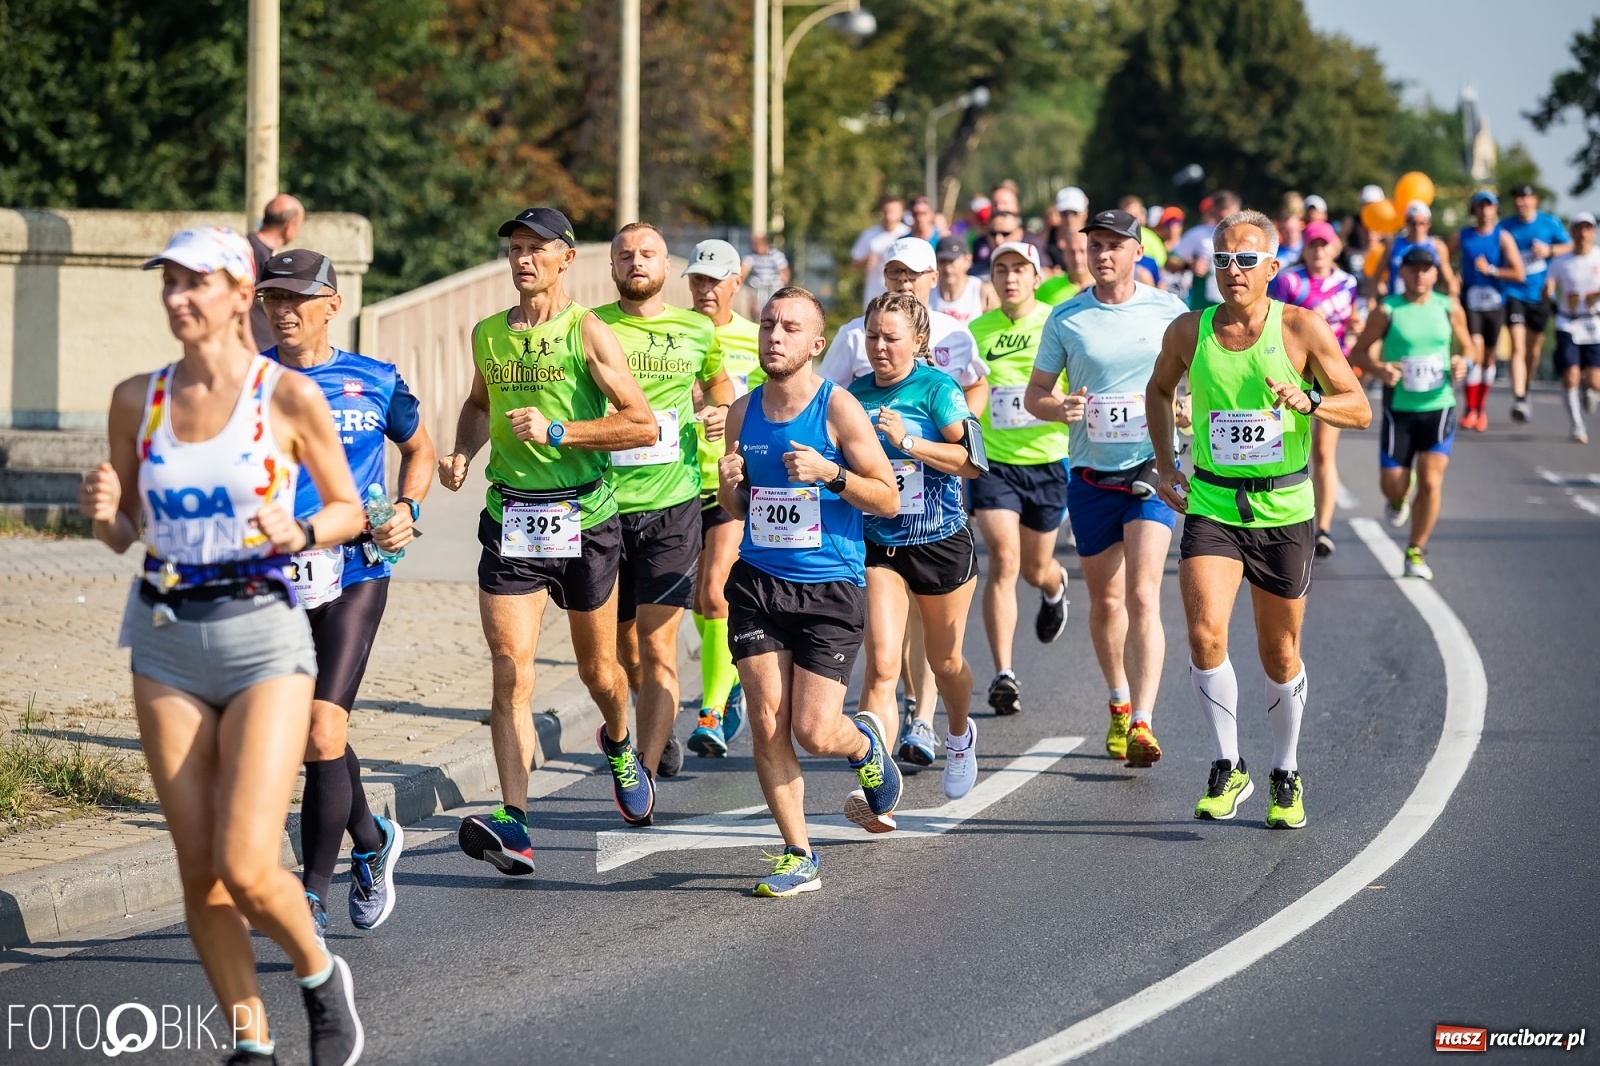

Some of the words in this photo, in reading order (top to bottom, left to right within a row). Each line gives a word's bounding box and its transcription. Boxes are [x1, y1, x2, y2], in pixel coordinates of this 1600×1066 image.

[995, 334, 1032, 349] RUN
[485, 358, 566, 385] Radlinioki
[625, 351, 692, 373] dlinioki
[640, 372, 673, 381] biegu
[512, 384, 544, 392] biegu
[1110, 407, 1128, 423] 51
[1230, 425, 1265, 443] 382
[147, 486, 235, 520] NOA
[766, 504, 801, 524] 206
[155, 518, 238, 548] RUN
[526, 515, 561, 535] 395
